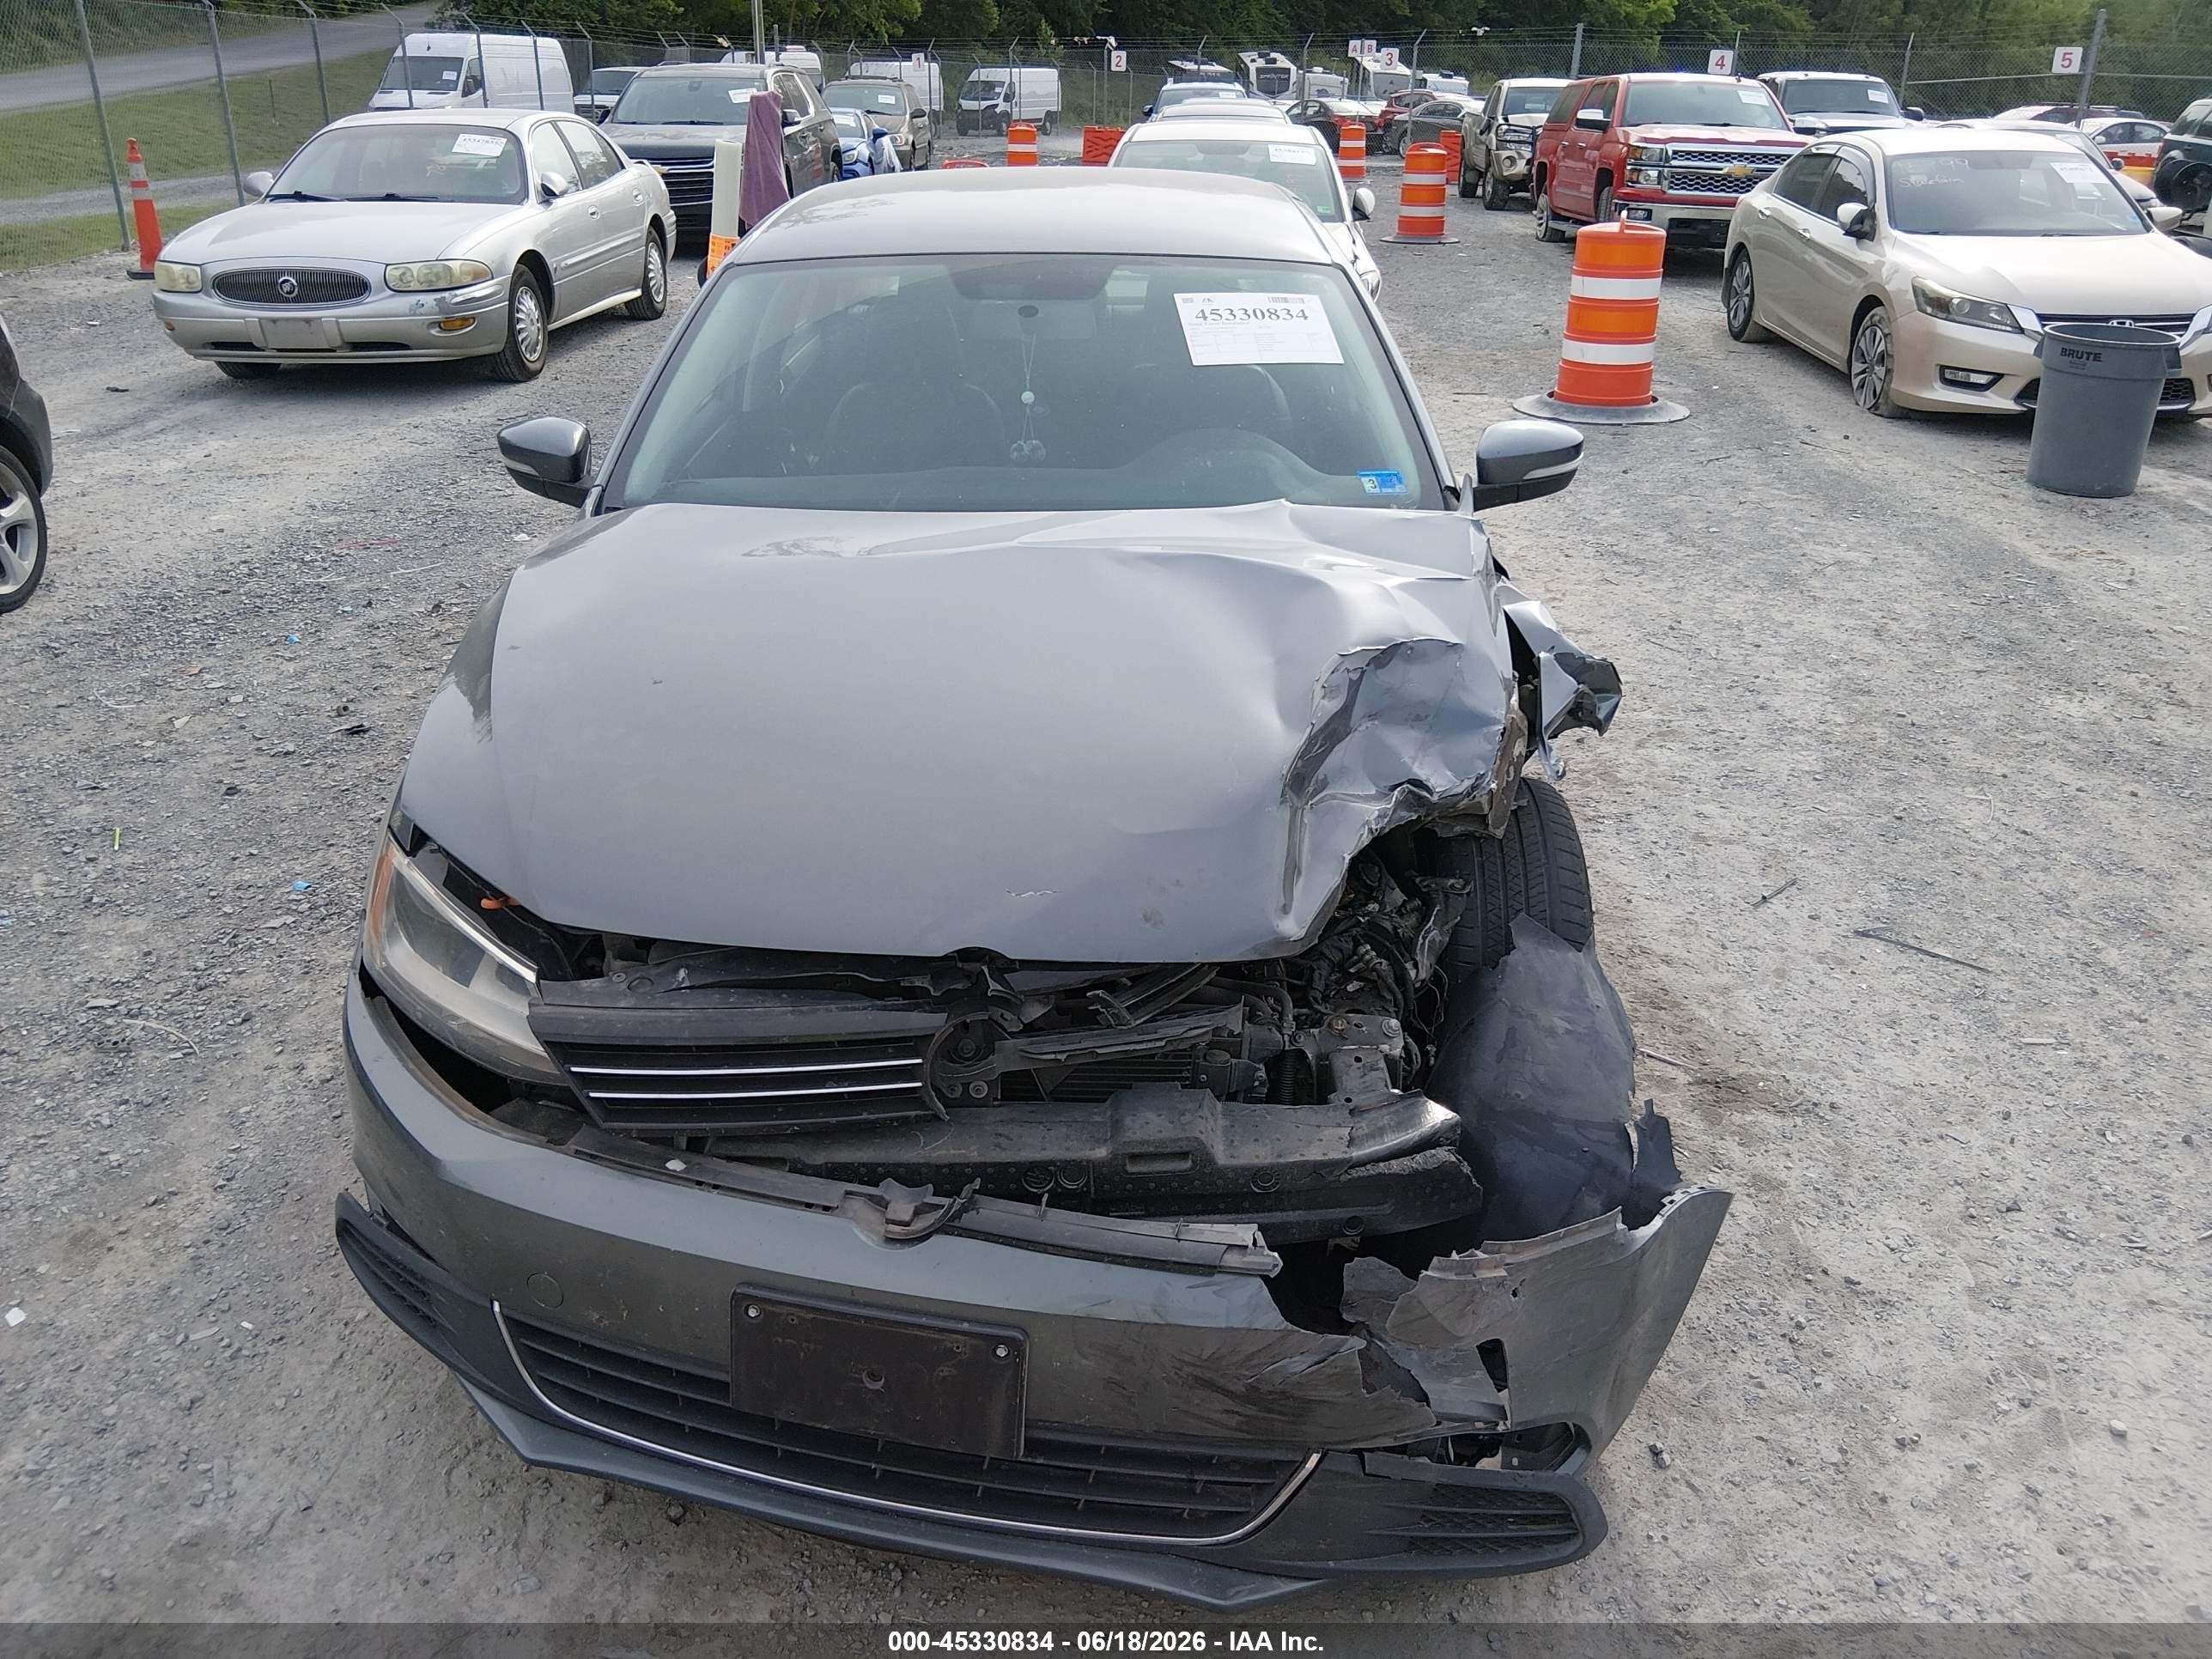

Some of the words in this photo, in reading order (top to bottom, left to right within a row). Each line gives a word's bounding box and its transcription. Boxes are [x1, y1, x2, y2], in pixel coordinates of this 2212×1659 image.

[1352, 44, 1357, 53] A
[1367, 44, 1373, 53] B
[916, 57, 921, 69] 1
[1115, 55, 1121, 68] 2
[1385, 52, 1393, 66] 3
[1715, 54, 1726, 70] 4
[2060, 52, 2073, 69] 5
[1194, 307, 1309, 322] 45330834
[2060, 348, 2103, 362] BRUTE
[1367, 478, 1376, 489] 3
